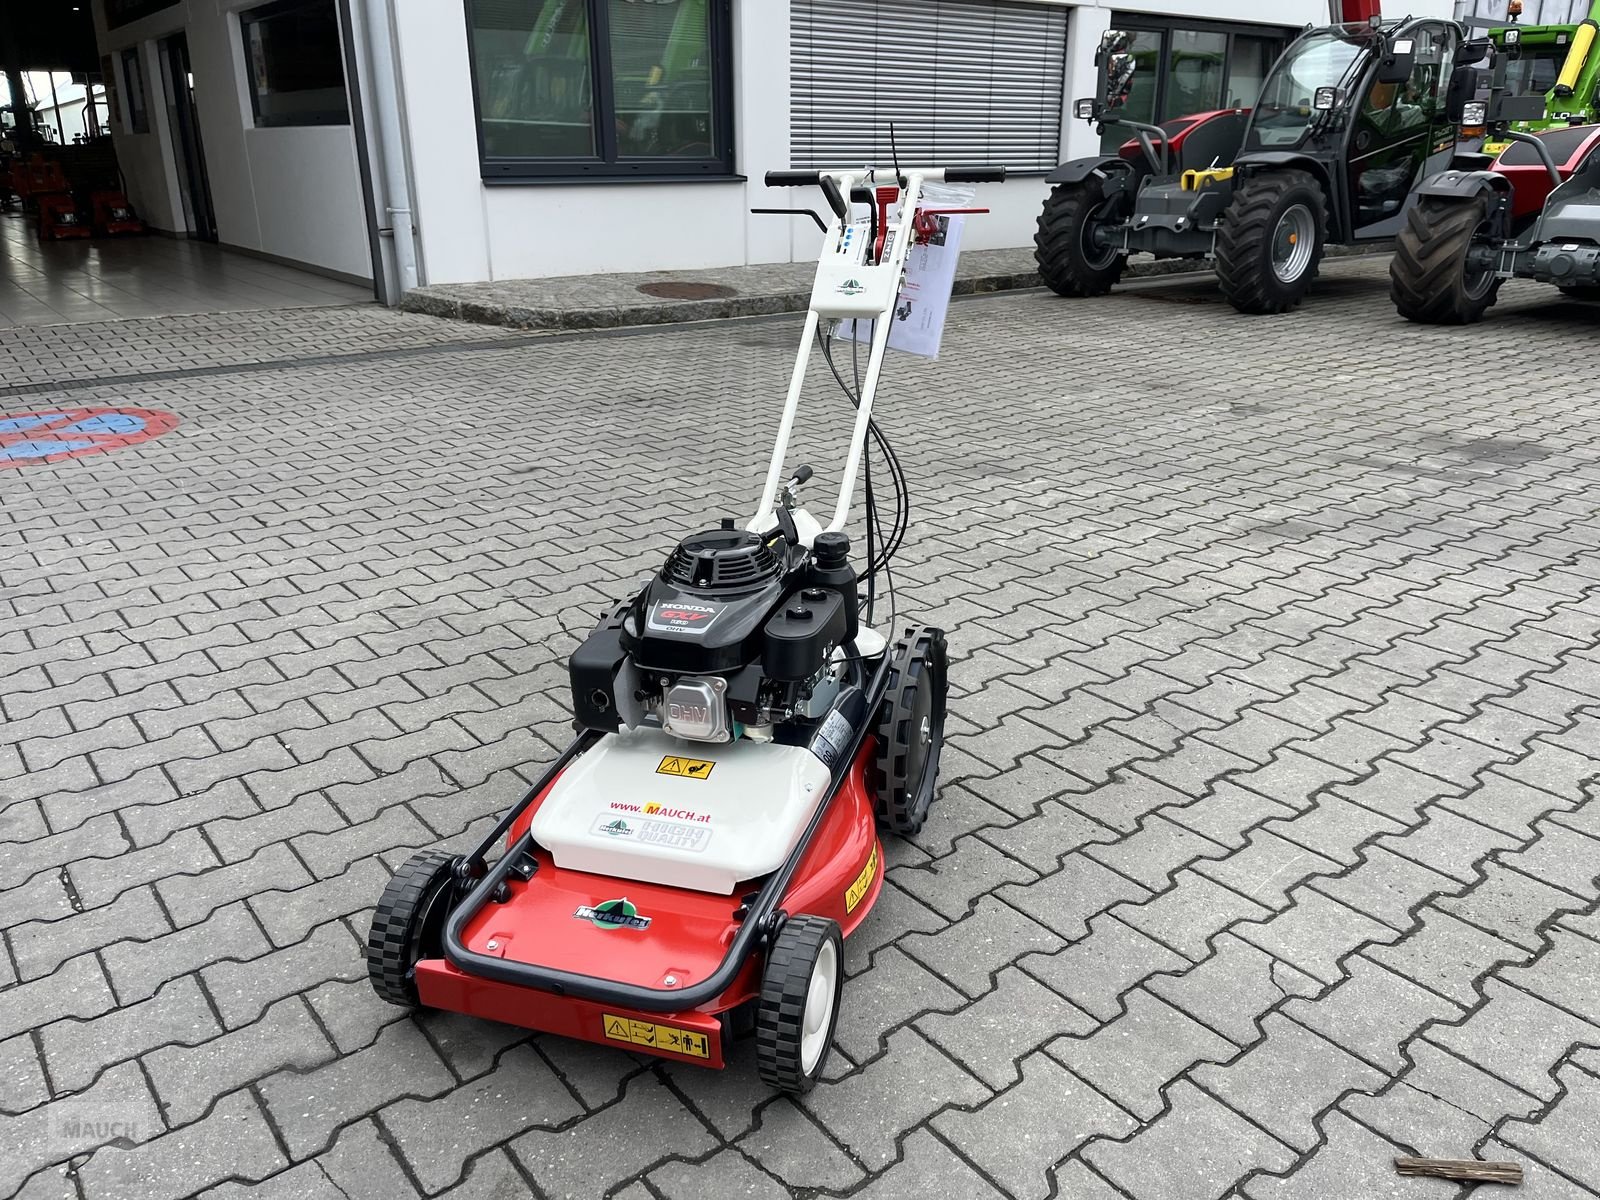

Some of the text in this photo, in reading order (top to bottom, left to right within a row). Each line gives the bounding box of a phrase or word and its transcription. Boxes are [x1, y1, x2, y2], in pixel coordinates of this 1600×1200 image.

[660, 603, 716, 613] HONDA
[660, 610, 709, 620] GXV
[669, 703, 707, 724] OHV
[638, 830, 700, 848] QUALITY
[641, 821, 705, 839] HIGH
